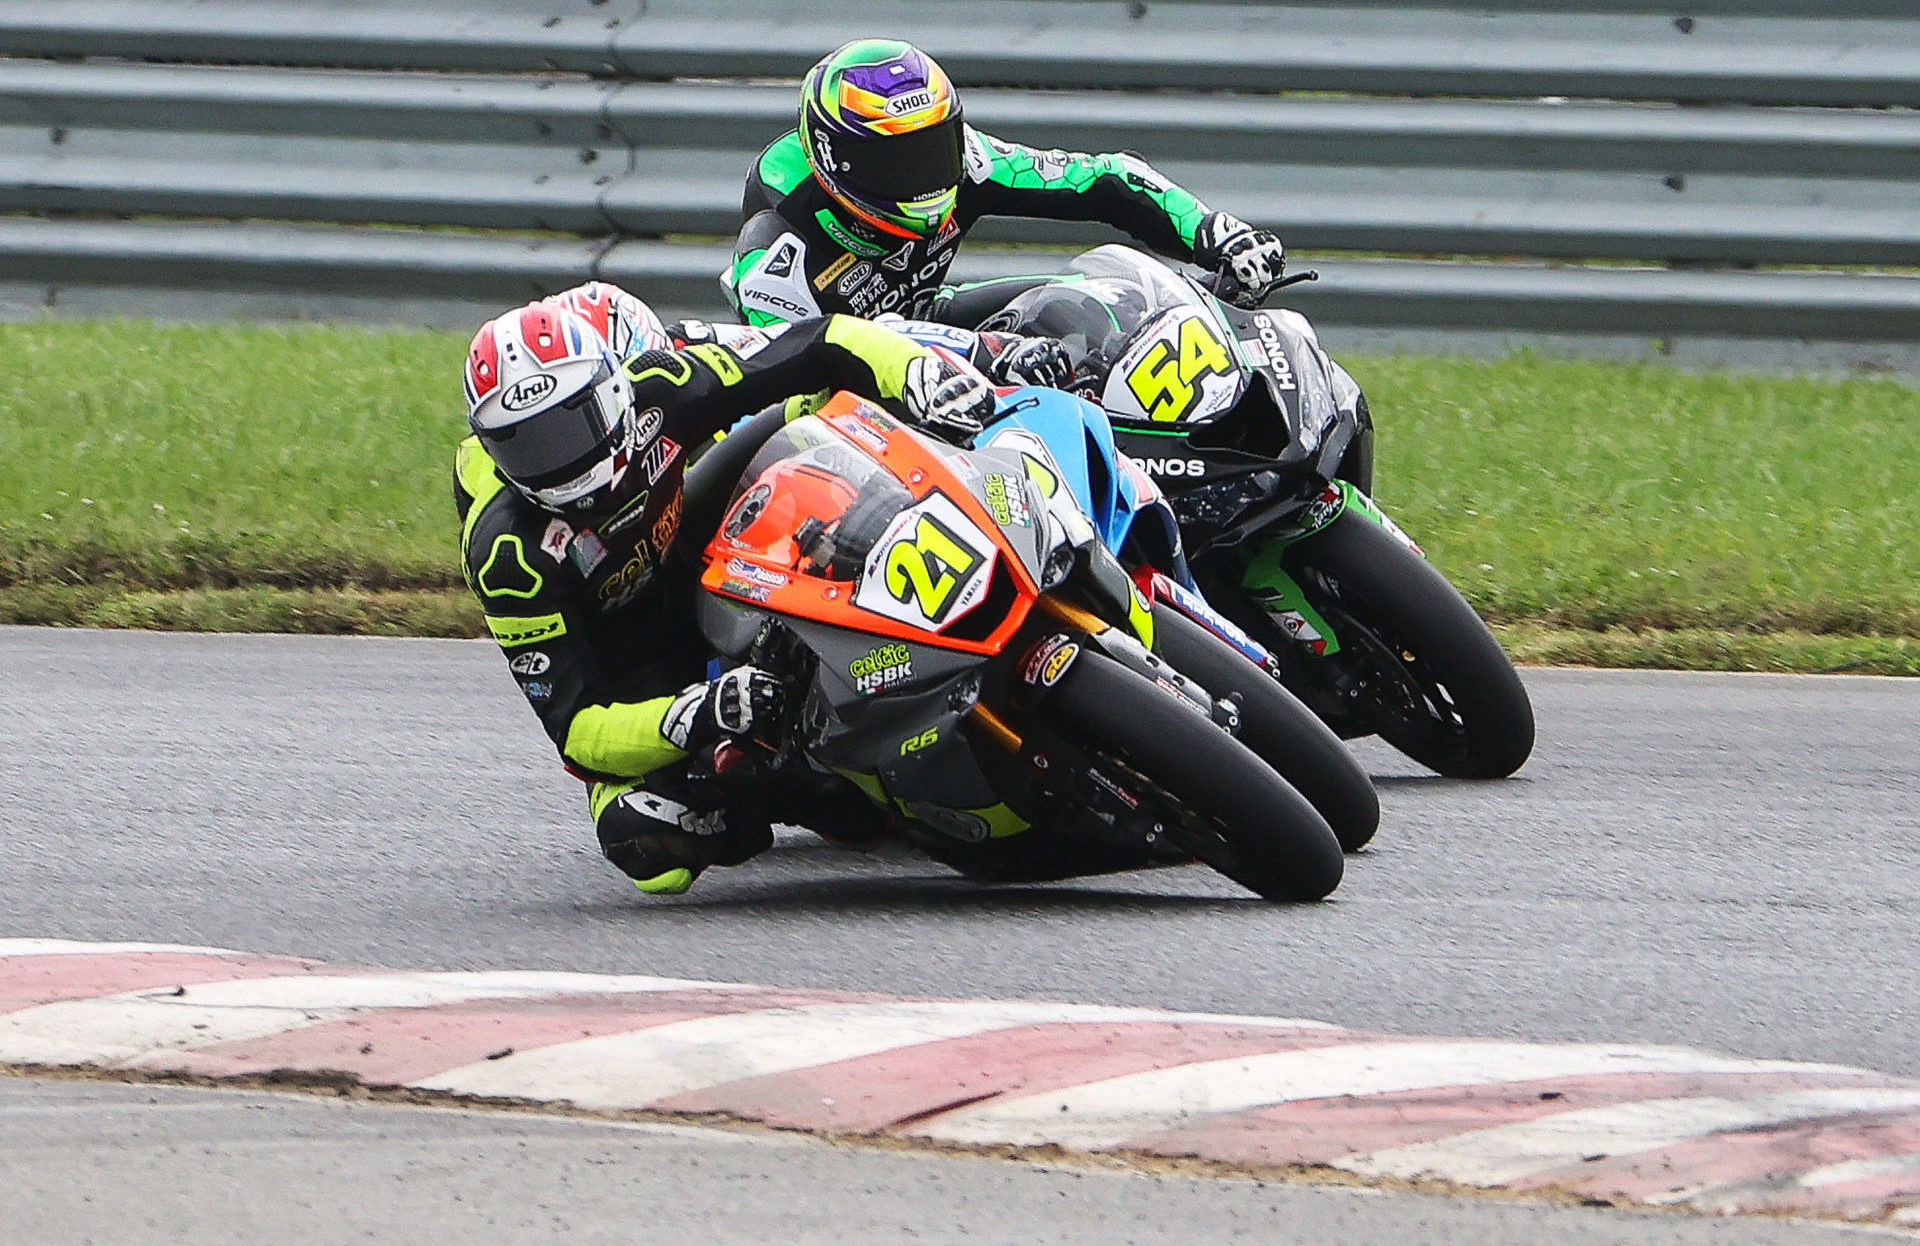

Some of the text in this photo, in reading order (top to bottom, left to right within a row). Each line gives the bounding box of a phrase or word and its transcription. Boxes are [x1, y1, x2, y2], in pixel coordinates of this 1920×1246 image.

[892, 93, 931, 113] SHOEI
[913, 188, 947, 202] HONOS
[841, 264, 868, 291] SHOEI
[867, 281, 888, 302] BAG
[744, 289, 809, 317] VIRCOS
[1253, 313, 1296, 391] HONOS
[1126, 316, 1234, 423] 54
[508, 375, 550, 403] Arai
[1130, 458, 1206, 477] ONOS
[1002, 474, 1025, 527] HSBK
[885, 512, 982, 620] 21
[856, 661, 913, 691] HSBK
[1045, 647, 1074, 681] sbs
[900, 726, 938, 756] R6
